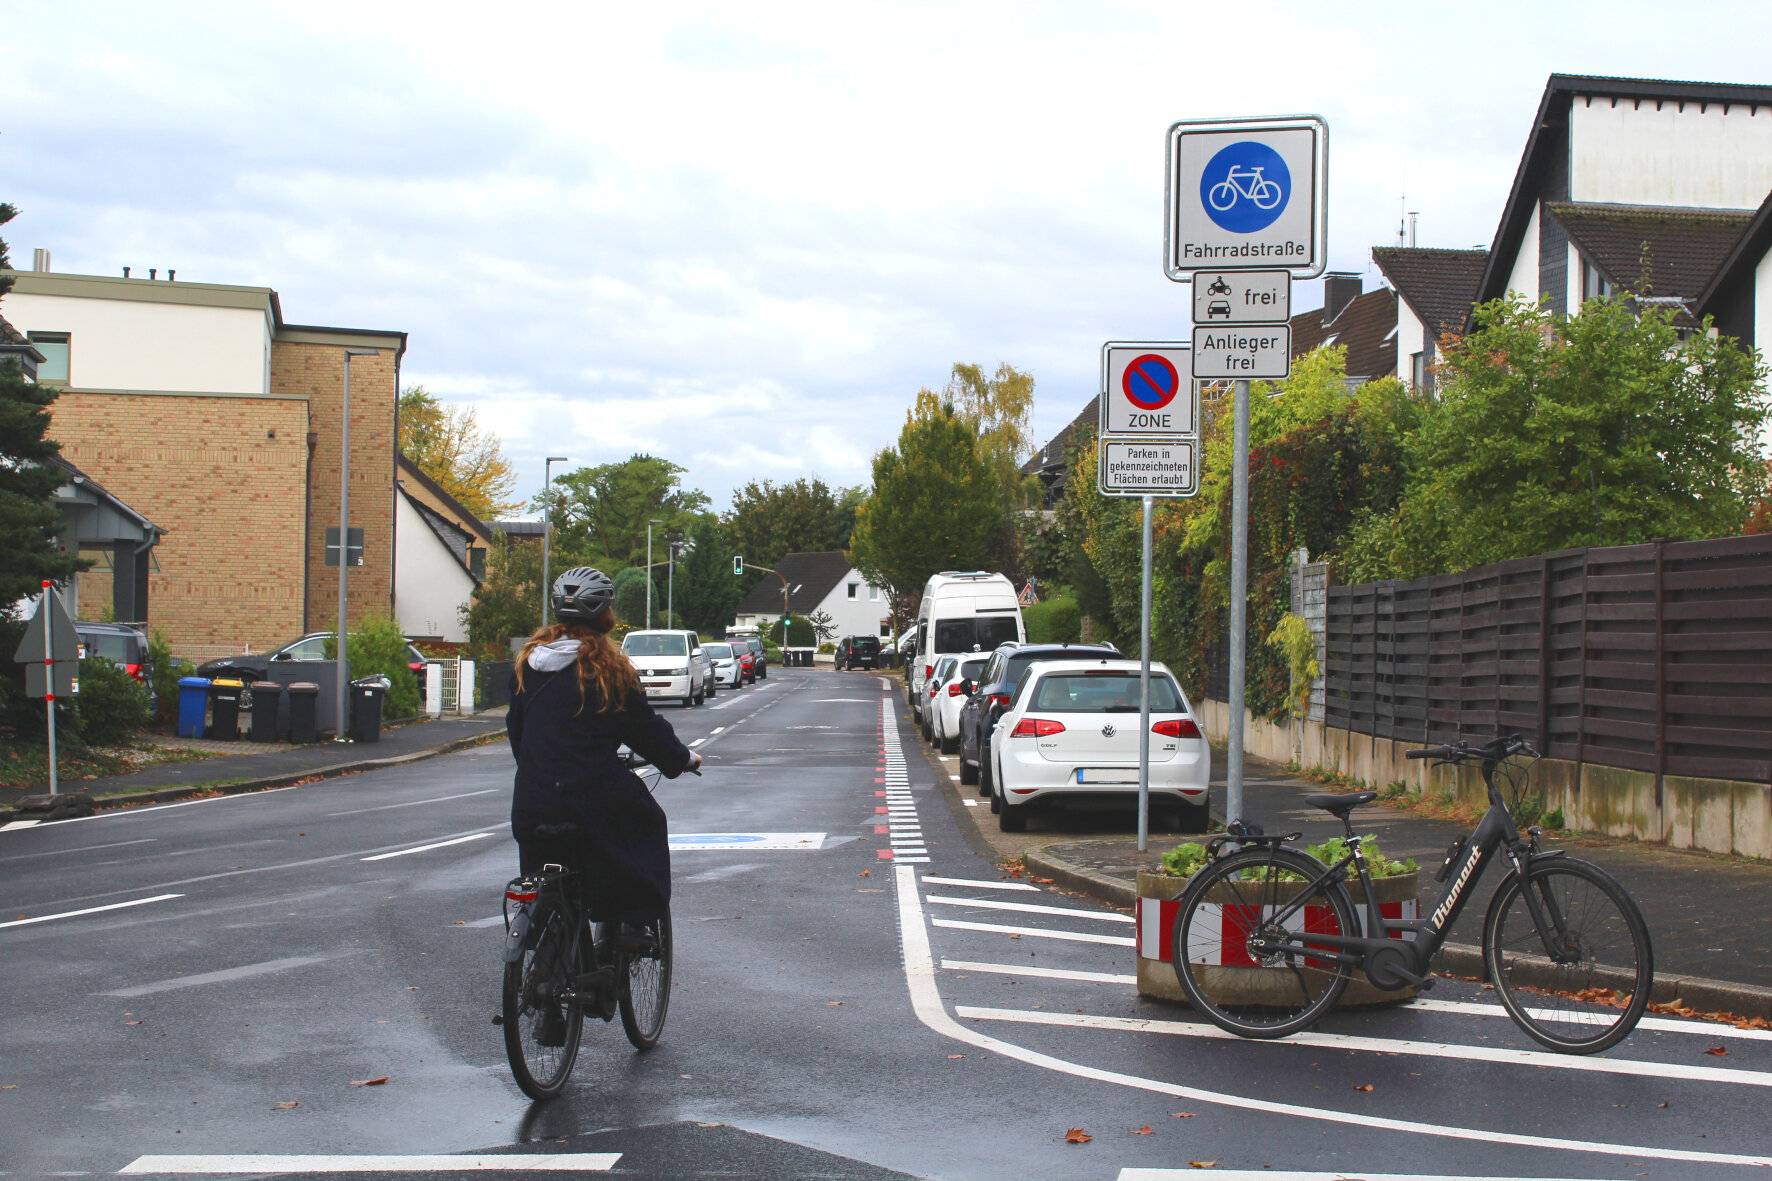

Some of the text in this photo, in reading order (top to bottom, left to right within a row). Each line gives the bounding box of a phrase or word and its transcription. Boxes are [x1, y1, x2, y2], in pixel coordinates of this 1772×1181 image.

[1184, 241, 1305, 259] Fahrradstraße
[1244, 288, 1277, 305] frei
[1203, 334, 1279, 353] Anlieger
[1225, 355, 1256, 370] frei
[1128, 414, 1172, 428] ZONE
[1127, 448, 1170, 459] Parken in
[1109, 461, 1188, 474] gekennzeichneten
[1113, 473, 1184, 485] Flächen erlaubt
[1431, 845, 1482, 930] Diamant
